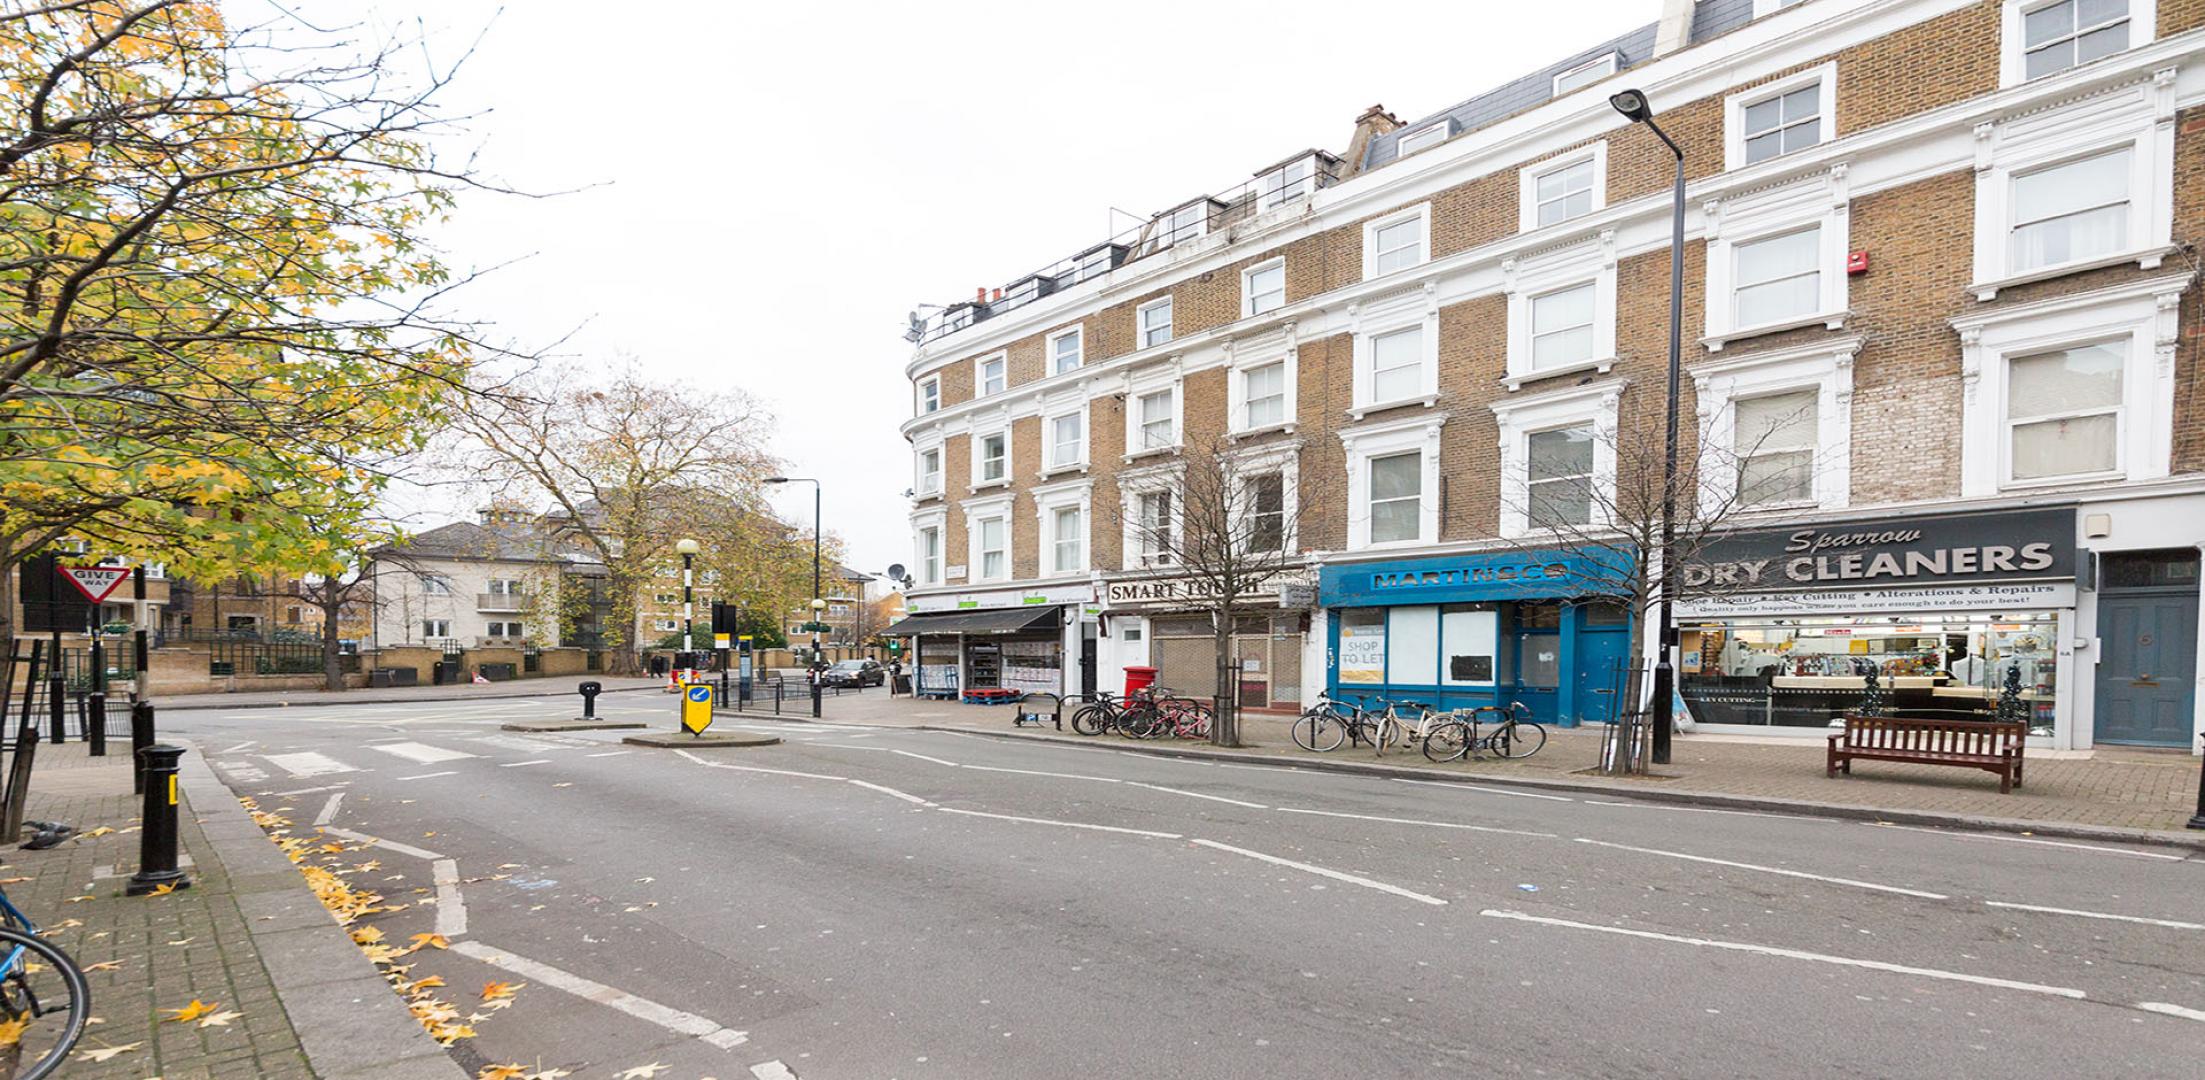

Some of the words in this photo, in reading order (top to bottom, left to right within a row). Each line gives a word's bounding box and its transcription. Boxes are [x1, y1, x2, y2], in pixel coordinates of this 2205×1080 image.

[1784, 529, 1921, 554] Sparrow
[1683, 559, 1770, 587] DRY
[1785, 542, 2054, 582] CLEANERS
[74, 571, 115, 579] GIVE
[1111, 583, 1177, 600] SMART
[1773, 594, 1799, 602] Key
[1802, 592, 1857, 601] Cutting
[1876, 587, 1964, 598] Alterations
[1968, 586, 1982, 595] &
[1988, 584, 2055, 595] Repairs
[1888, 600, 1931, 608] enough
[1348, 641, 1378, 652] SHOP
[1341, 653, 1358, 664] TO
[1362, 653, 1384, 664] LET
